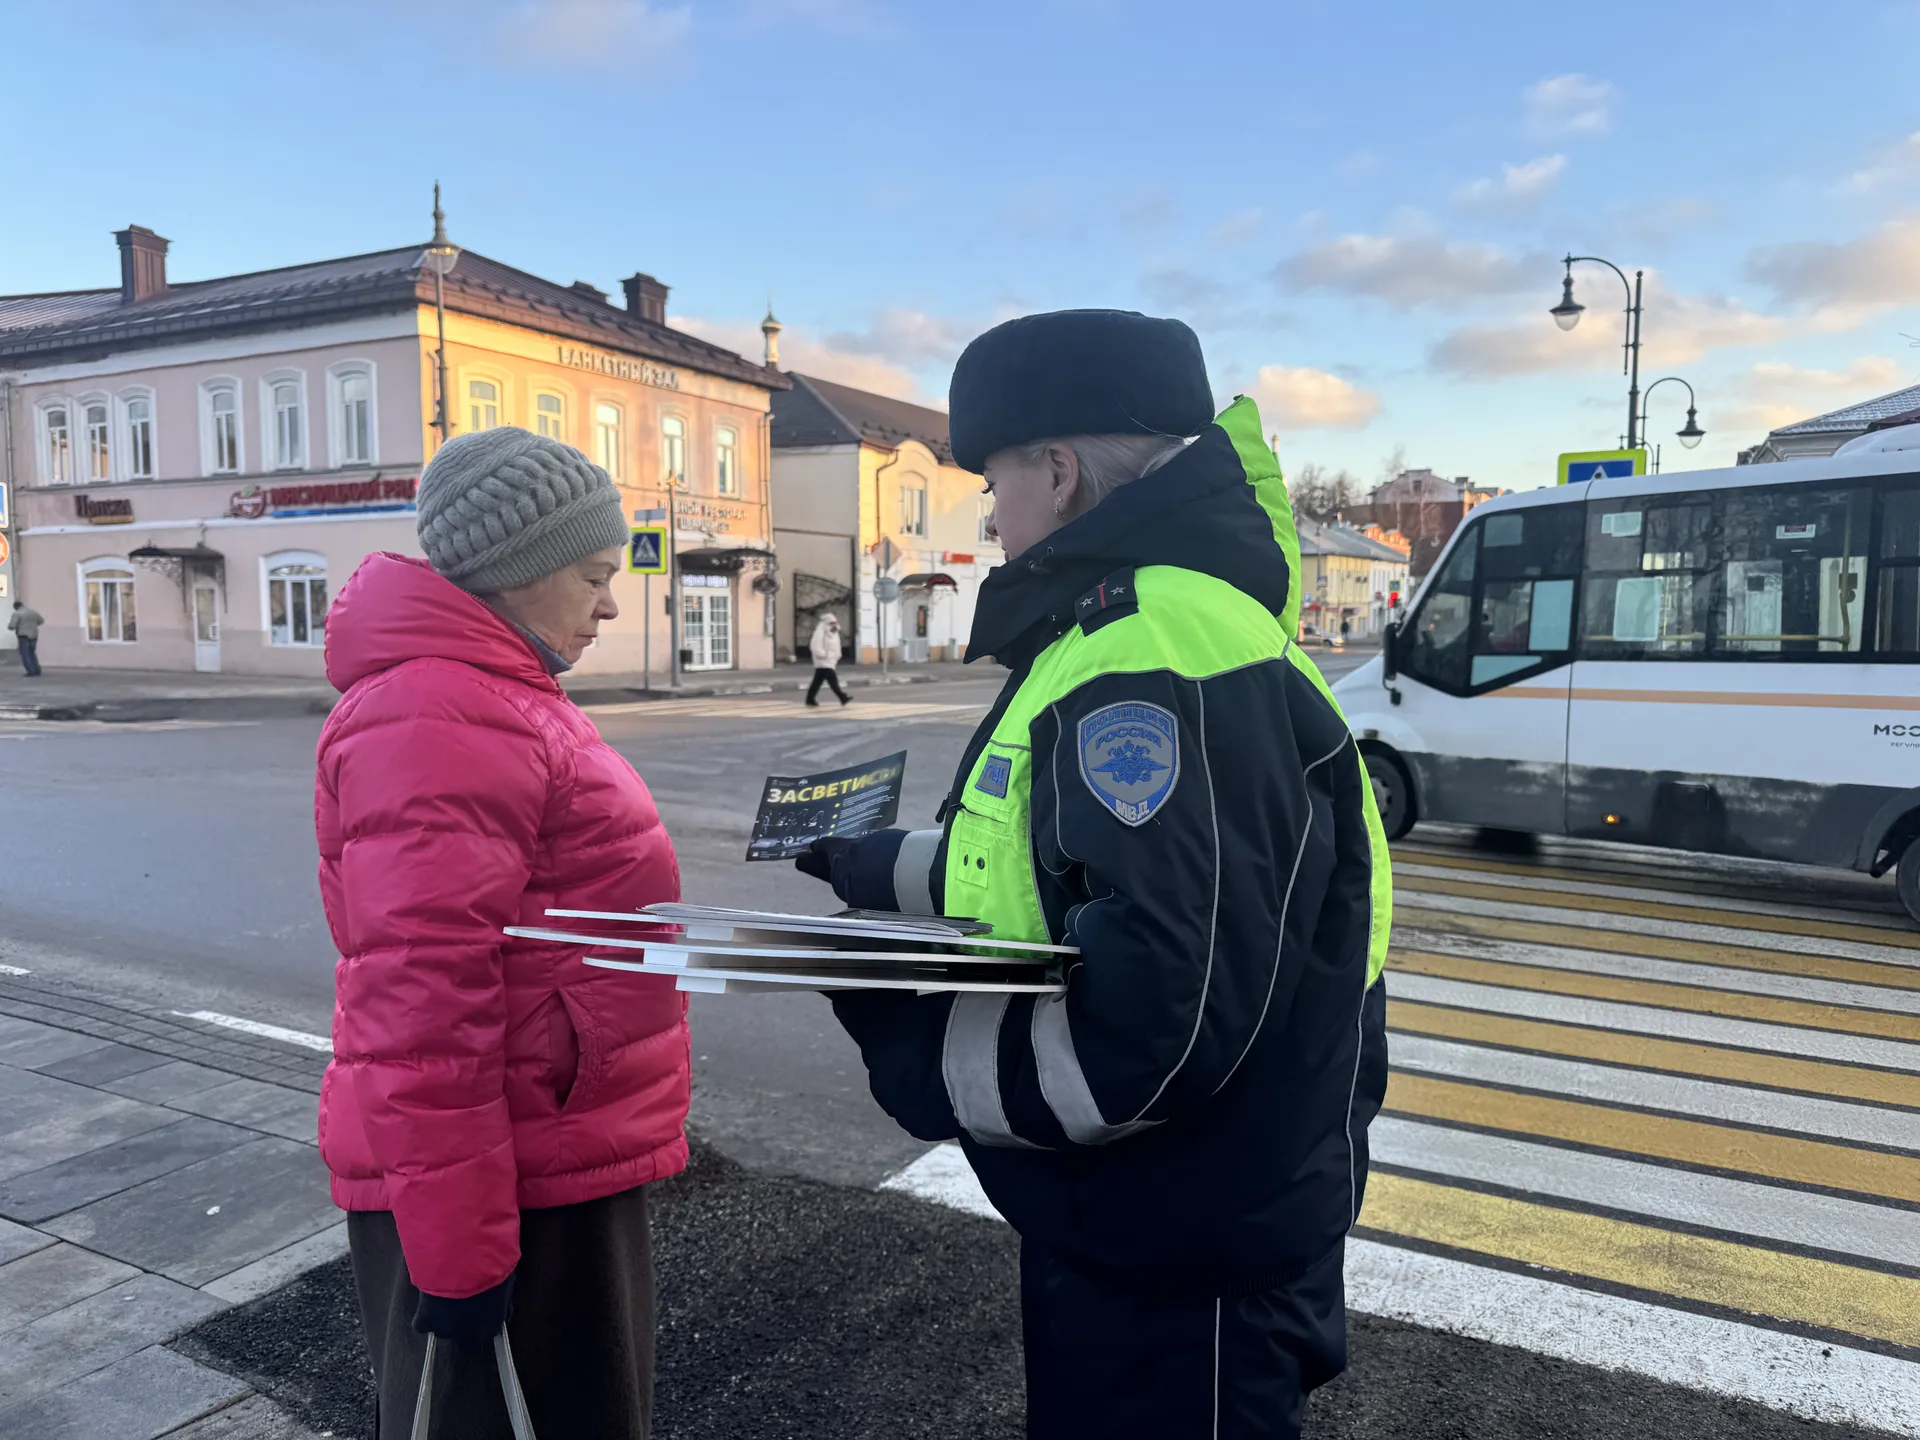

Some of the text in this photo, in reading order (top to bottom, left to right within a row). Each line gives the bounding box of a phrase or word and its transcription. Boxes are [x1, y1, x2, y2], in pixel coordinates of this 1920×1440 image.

[1085, 707, 1170, 737] ПОЛИЦИЯ
[1096, 726, 1162, 750] РОССИЯ
[1115, 799, 1150, 822] МВД
